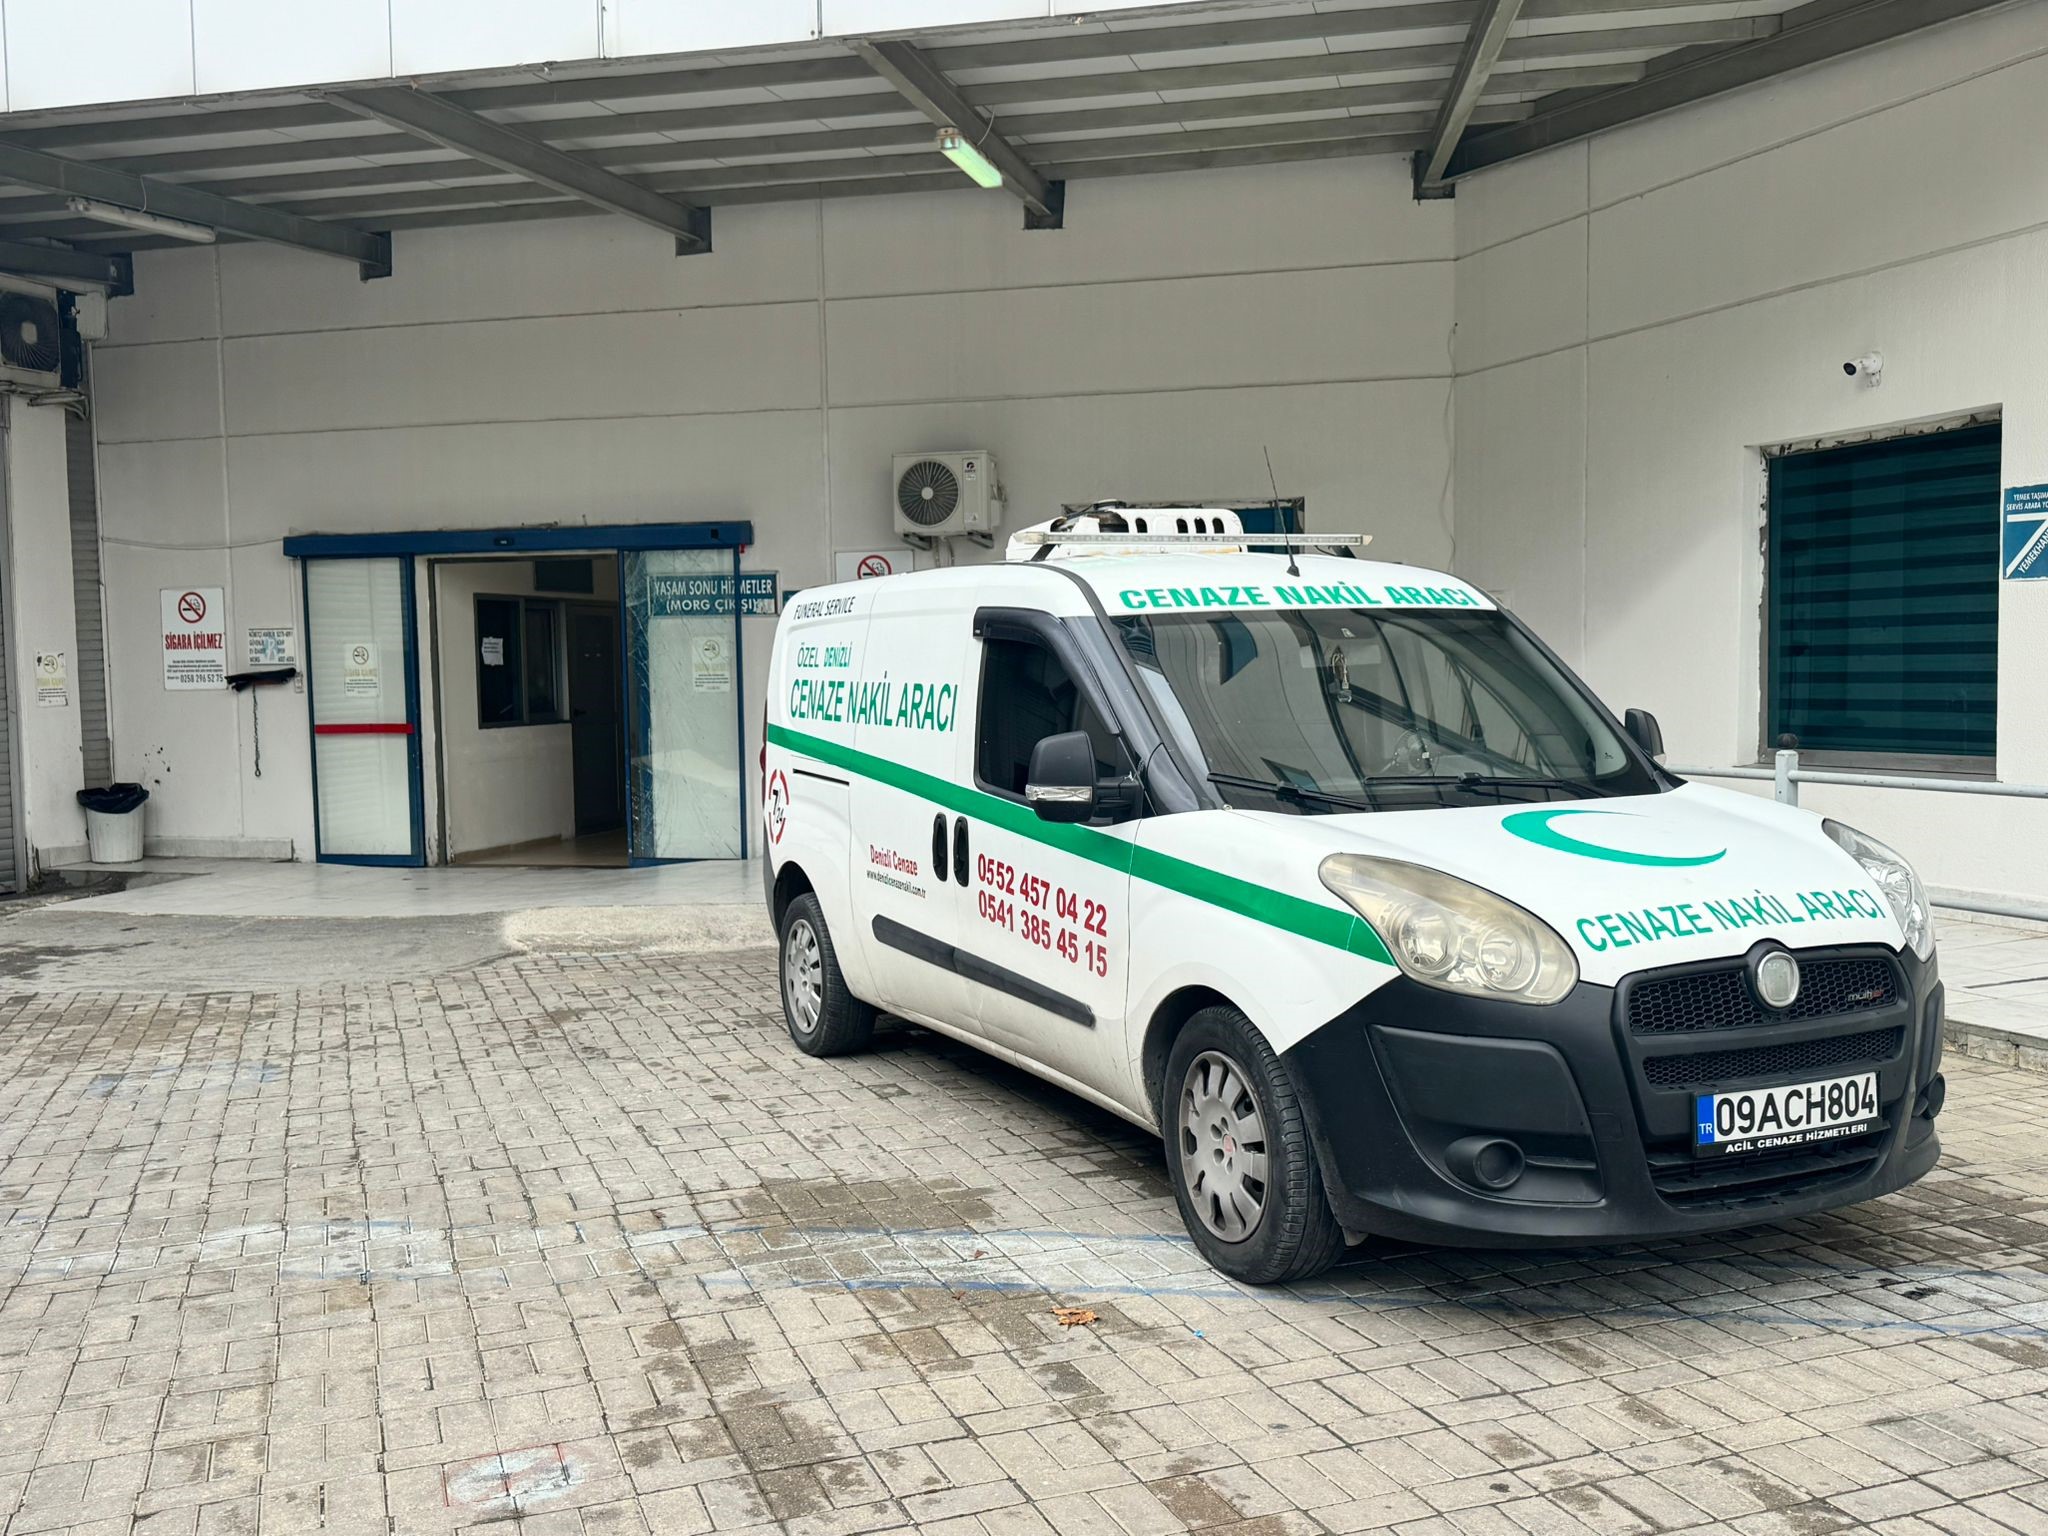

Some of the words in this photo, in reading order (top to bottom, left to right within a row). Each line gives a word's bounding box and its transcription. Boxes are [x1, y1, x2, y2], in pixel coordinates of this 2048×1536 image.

[2013, 493, 2030, 501] YEMEK
[2024, 501, 2041, 510] ARABA
[2018, 528, 2048, 574] YEMEKHAN
[654, 580, 687, 599] YAŞAM
[689, 580, 718, 596] SONU
[1118, 585, 1271, 609] CENAZE
[1275, 581, 1383, 605] NAKİL
[1383, 585, 1480, 607] ARACI
[666, 598, 711, 614] (MORG
[793, 601, 824, 620] FUNERAL
[824, 596, 856, 616] SERVICE
[165, 631, 193, 650] SİGARA
[193, 630, 223, 652] İÇİLMEZ
[797, 641, 819, 668] ÖZEL
[823, 640, 853, 667] DENİZLİ
[790, 678, 845, 722] CENAZE
[846, 670, 893, 727] NAKİL
[895, 682, 958, 732] ARACI
[870, 844, 892, 868] Denizli
[892, 850, 918, 876] Cenaze
[977, 853, 1015, 896] 0552
[1019, 872, 1051, 911] 457
[1056, 887, 1078, 925] 04
[1084, 898, 1107, 938] 22
[978, 889, 1014, 933] 0541
[1020, 909, 1051, 951] 385
[1056, 927, 1079, 964] 45
[1085, 940, 1108, 978] 15
[1576, 903, 1714, 952] CENAZE
[1703, 889, 1806, 930] NAKİL
[1796, 889, 1887, 921] ARACI
[1699, 1122, 1713, 1135] TR
[1716, 1076, 1875, 1137] 09ACH804
[1725, 1138, 1754, 1153] ACİL
[1757, 1134, 1803, 1149] CENAZE
